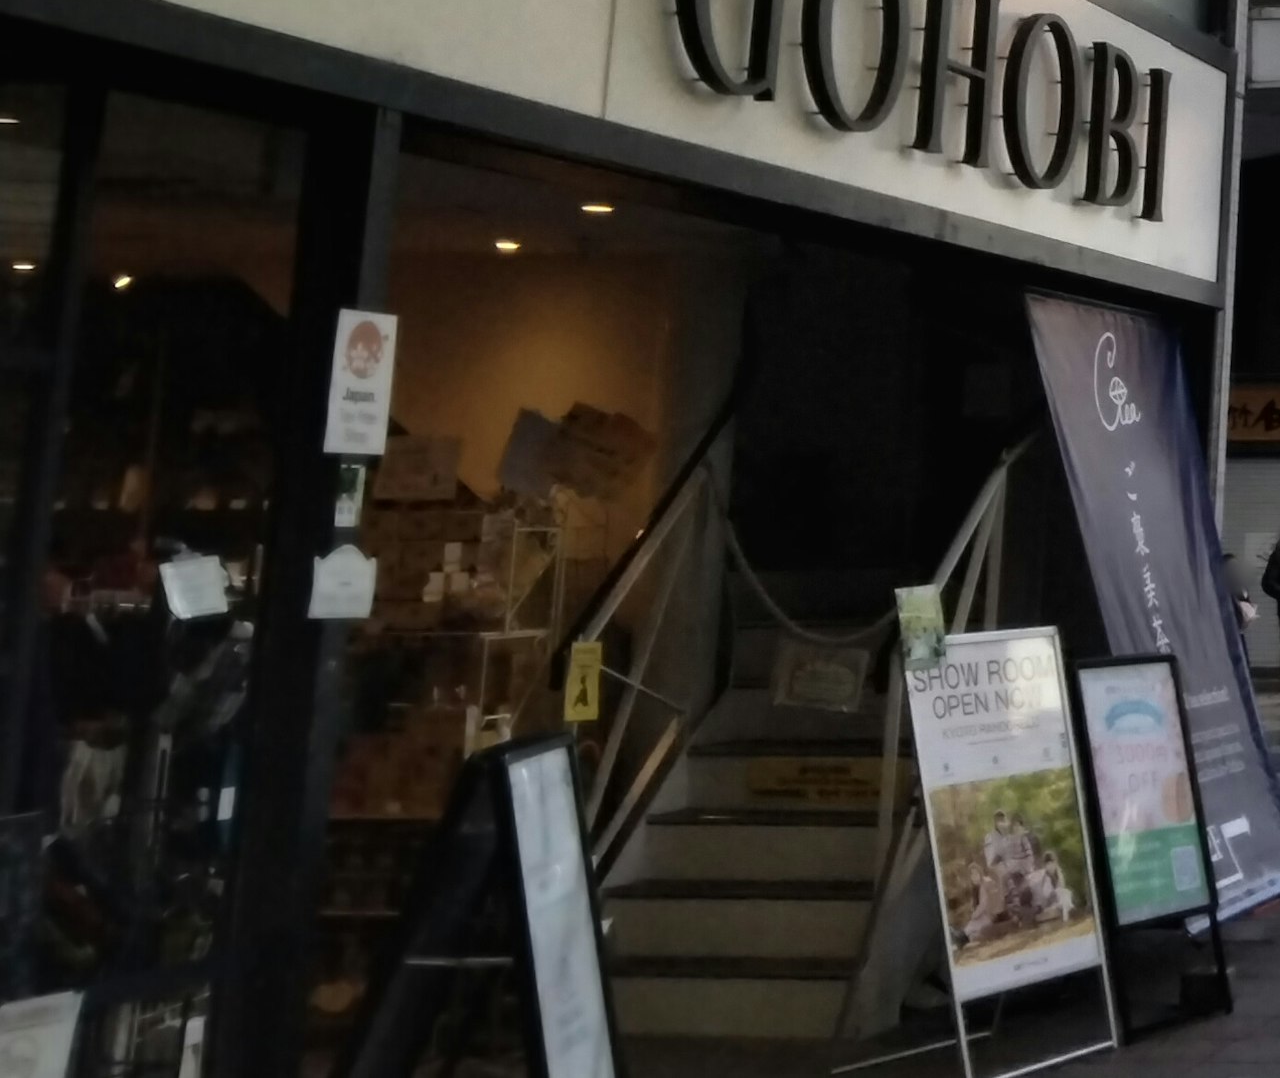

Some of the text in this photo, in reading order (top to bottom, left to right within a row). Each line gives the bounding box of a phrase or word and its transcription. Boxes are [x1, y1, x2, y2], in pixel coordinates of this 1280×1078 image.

[912, 654, 1054, 693] SHOW ROOM
[932, 692, 989, 720] OPEN
[1128, 770, 1160, 795] OFF
